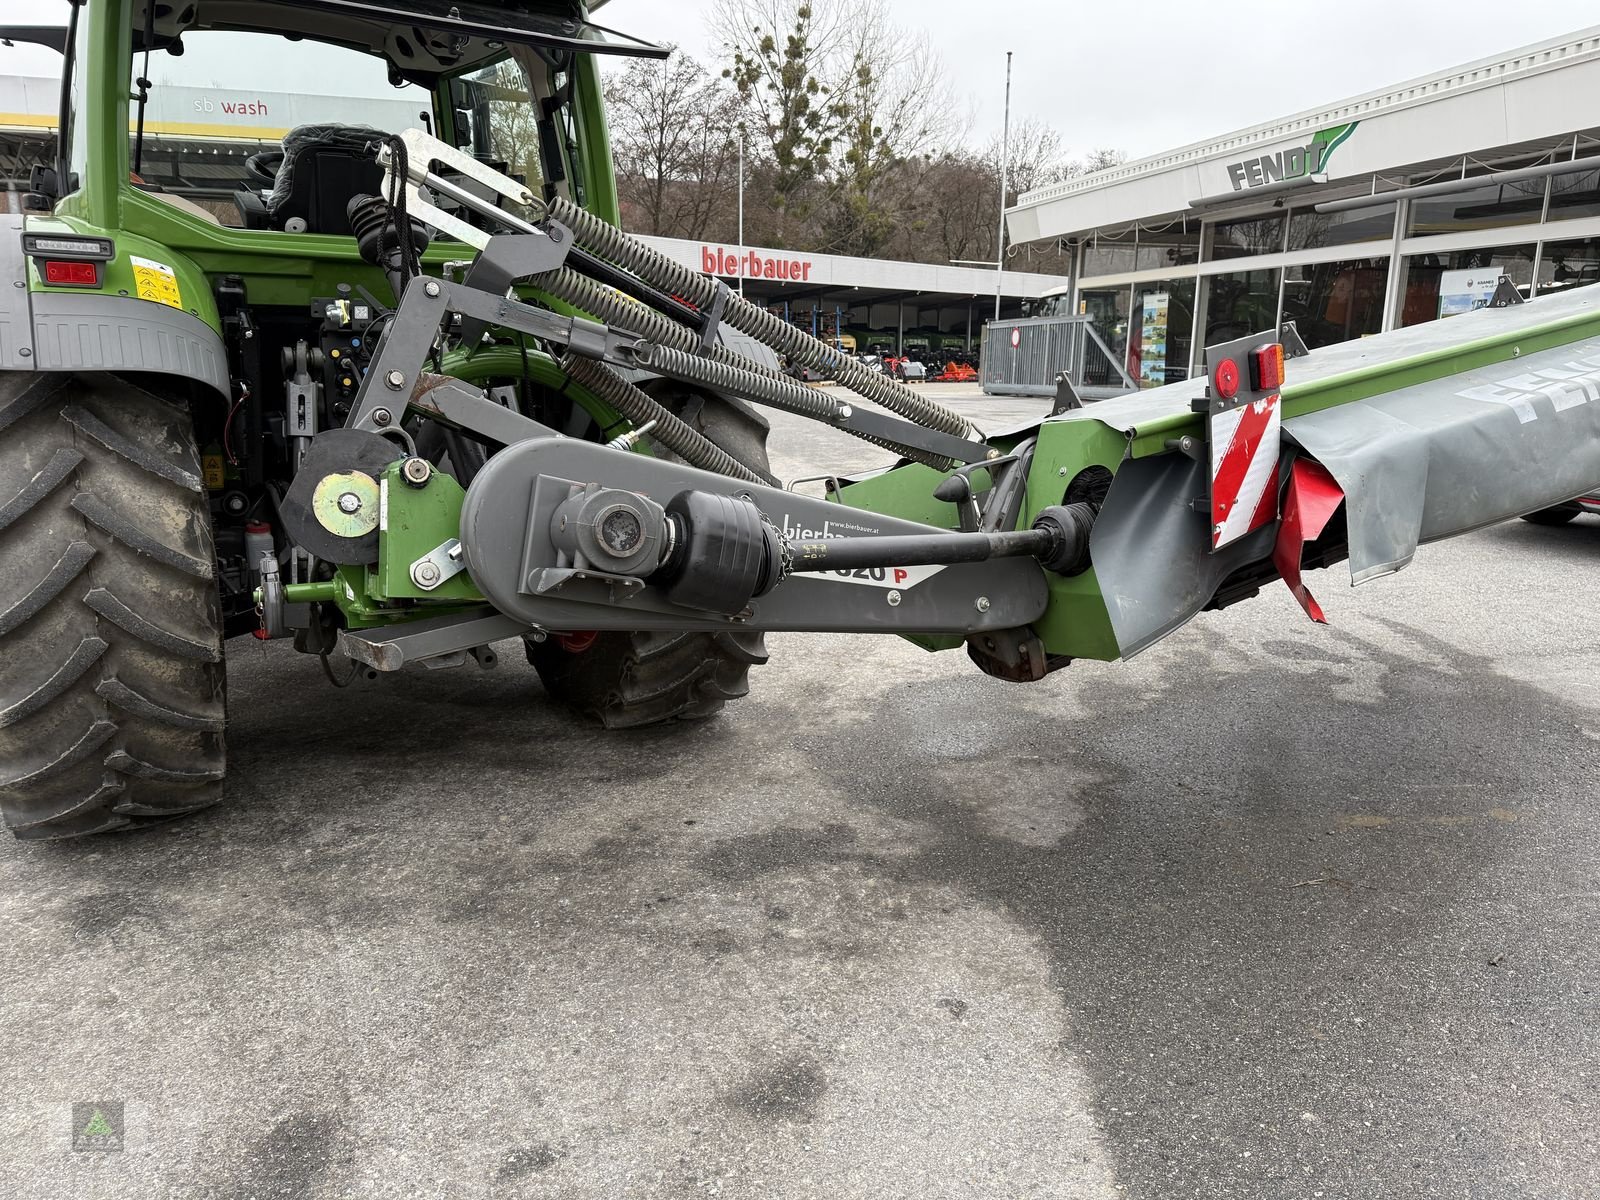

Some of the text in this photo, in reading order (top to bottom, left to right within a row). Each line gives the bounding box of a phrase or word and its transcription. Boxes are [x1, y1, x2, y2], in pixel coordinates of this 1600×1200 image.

[192, 96, 268, 115] sb wash
[1226, 141, 1328, 191] FENDT
[702, 245, 812, 281] bierbauer
[829, 521, 880, 535] www.bierbauer.at
[893, 568, 908, 584] P
